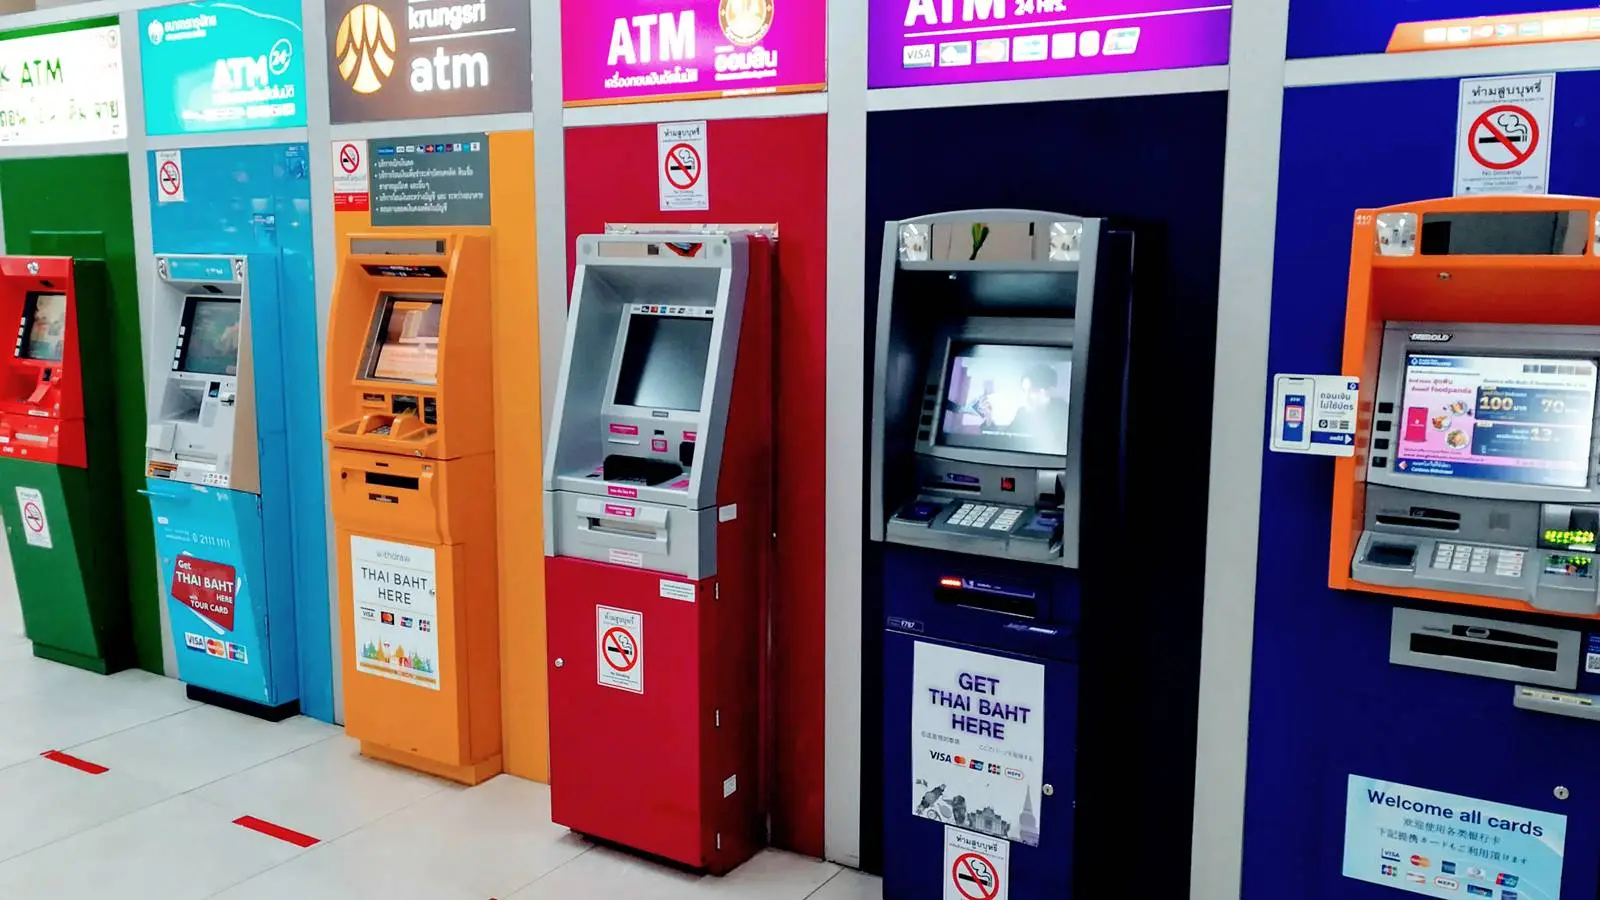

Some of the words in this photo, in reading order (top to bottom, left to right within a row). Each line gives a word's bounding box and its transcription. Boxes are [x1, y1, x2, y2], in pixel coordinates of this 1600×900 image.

[408, 3, 486, 30] krungsri
[606, 10, 697, 65] ATM
[907, 49, 932, 65] VISA
[21, 56, 64, 88] ATM
[211, 55, 270, 91] ATM
[410, 47, 490, 93] atm
[1472, 81, 1542, 102] ห้ามสูบบุหรี่
[1480, 396, 1513, 410] 100
[178, 560, 193, 571] Get
[376, 549, 411, 563] withdraw
[176, 571, 201, 587] THAI
[205, 576, 234, 593] BAHT
[361, 567, 390, 584] THAI
[393, 573, 428, 591] BAHT
[216, 594, 233, 604] HERE
[378, 587, 412, 605] HERE
[210, 602, 229, 614] CARD
[187, 635, 204, 647] VISA
[958, 672, 1000, 696] GET
[928, 688, 971, 712] THAI
[978, 699, 1031, 724] BAHT
[952, 714, 1005, 741] HERE
[929, 750, 953, 763] VISA
[1367, 788, 1454, 819] Welcome
[1459, 810, 1481, 825] all
[1486, 816, 1544, 838] cards
[1384, 849, 1400, 858] VISA
